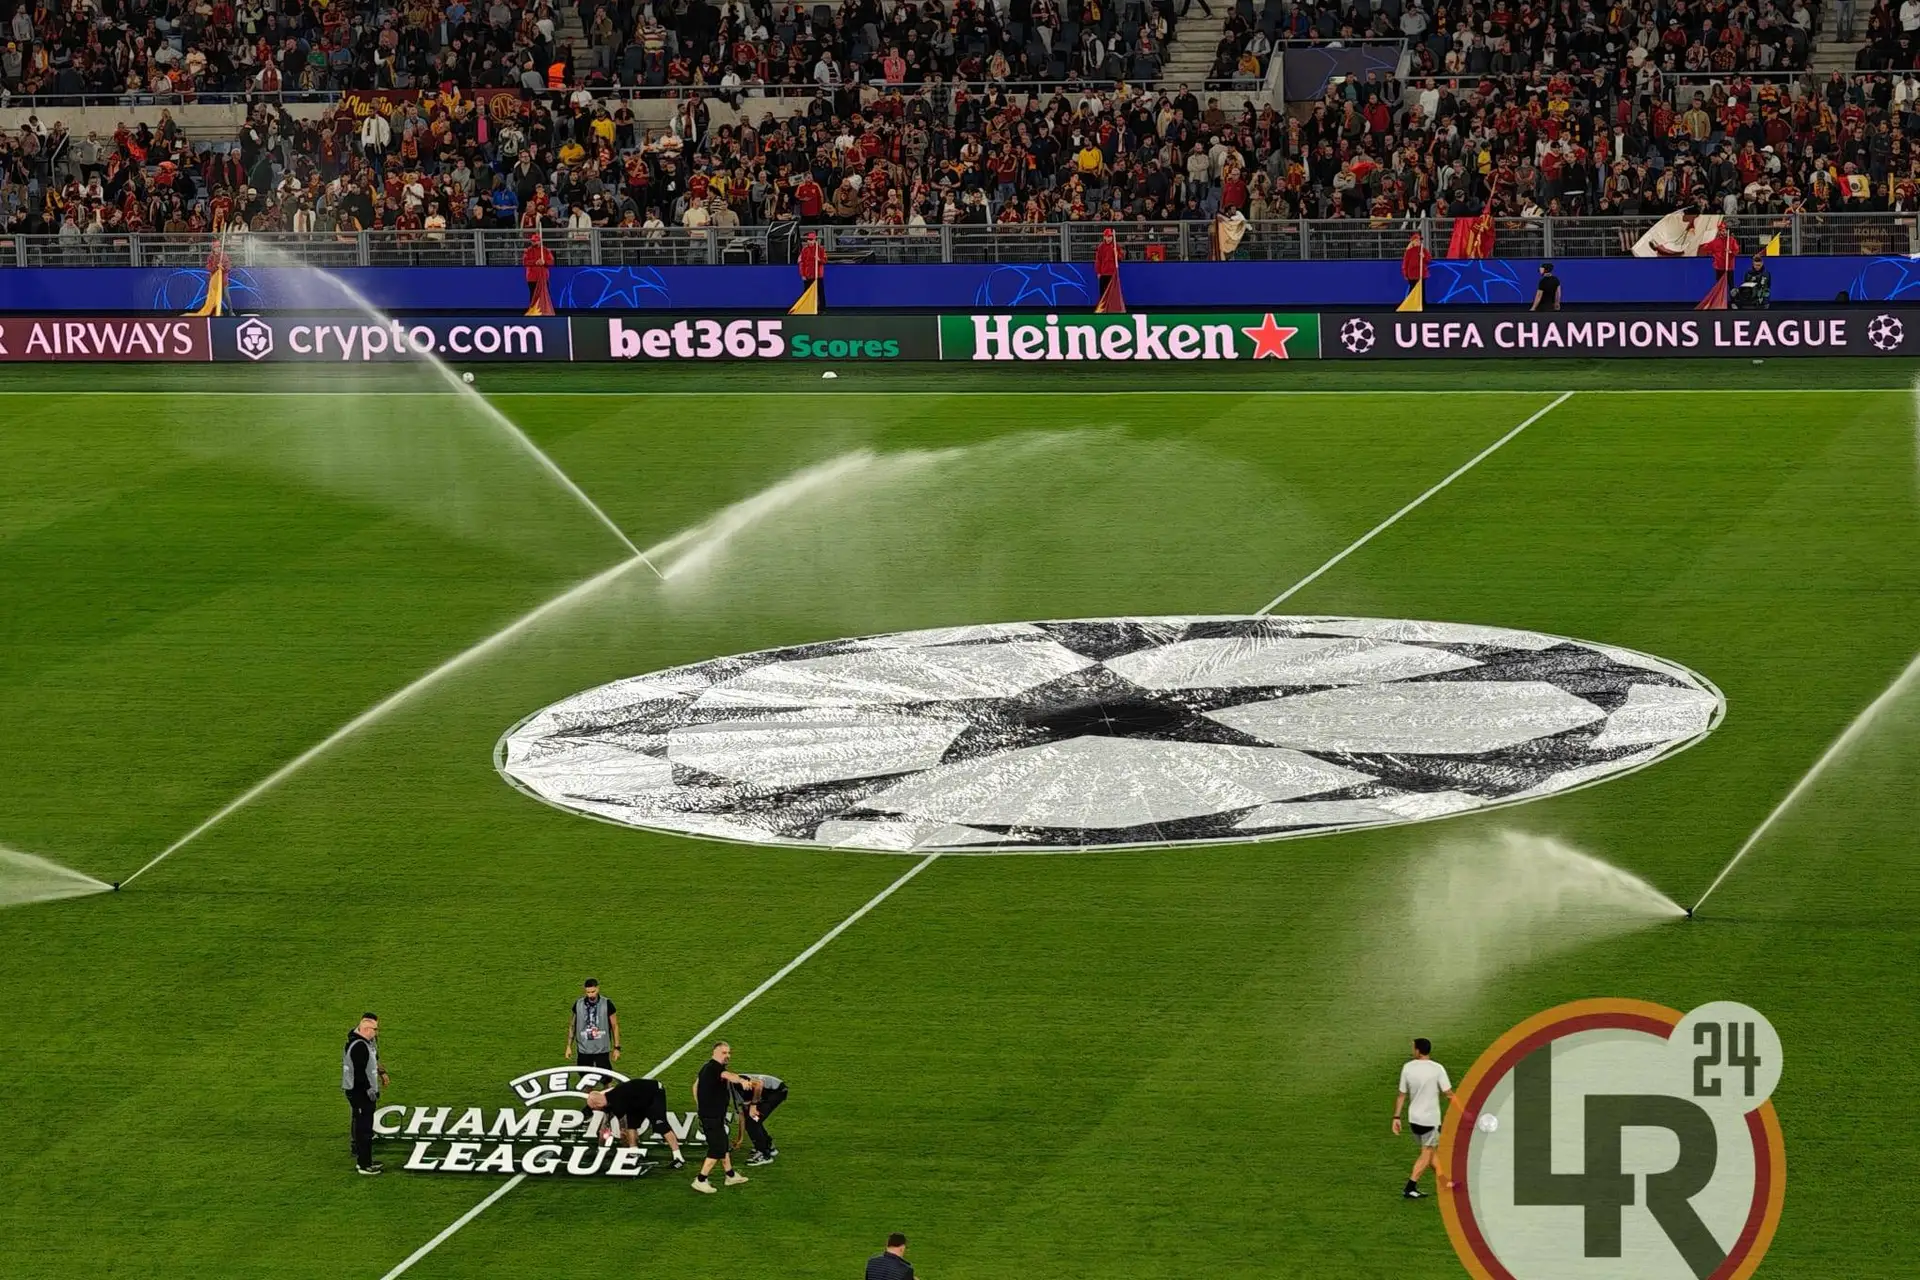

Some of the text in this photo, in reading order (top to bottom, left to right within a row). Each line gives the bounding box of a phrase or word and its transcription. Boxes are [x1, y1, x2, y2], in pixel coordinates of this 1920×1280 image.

[26, 322, 193, 354] AIRWAYS
[289, 320, 543, 360] crypto.com
[609, 318, 899, 358] bet365 Scores
[971, 314, 1239, 360] Heineken
[1395, 320, 1847, 349] UEFA CHAMPIONS LEAGUE
[515, 1072, 603, 1100] UEF
[403, 1141, 648, 1176] LEAGUE
